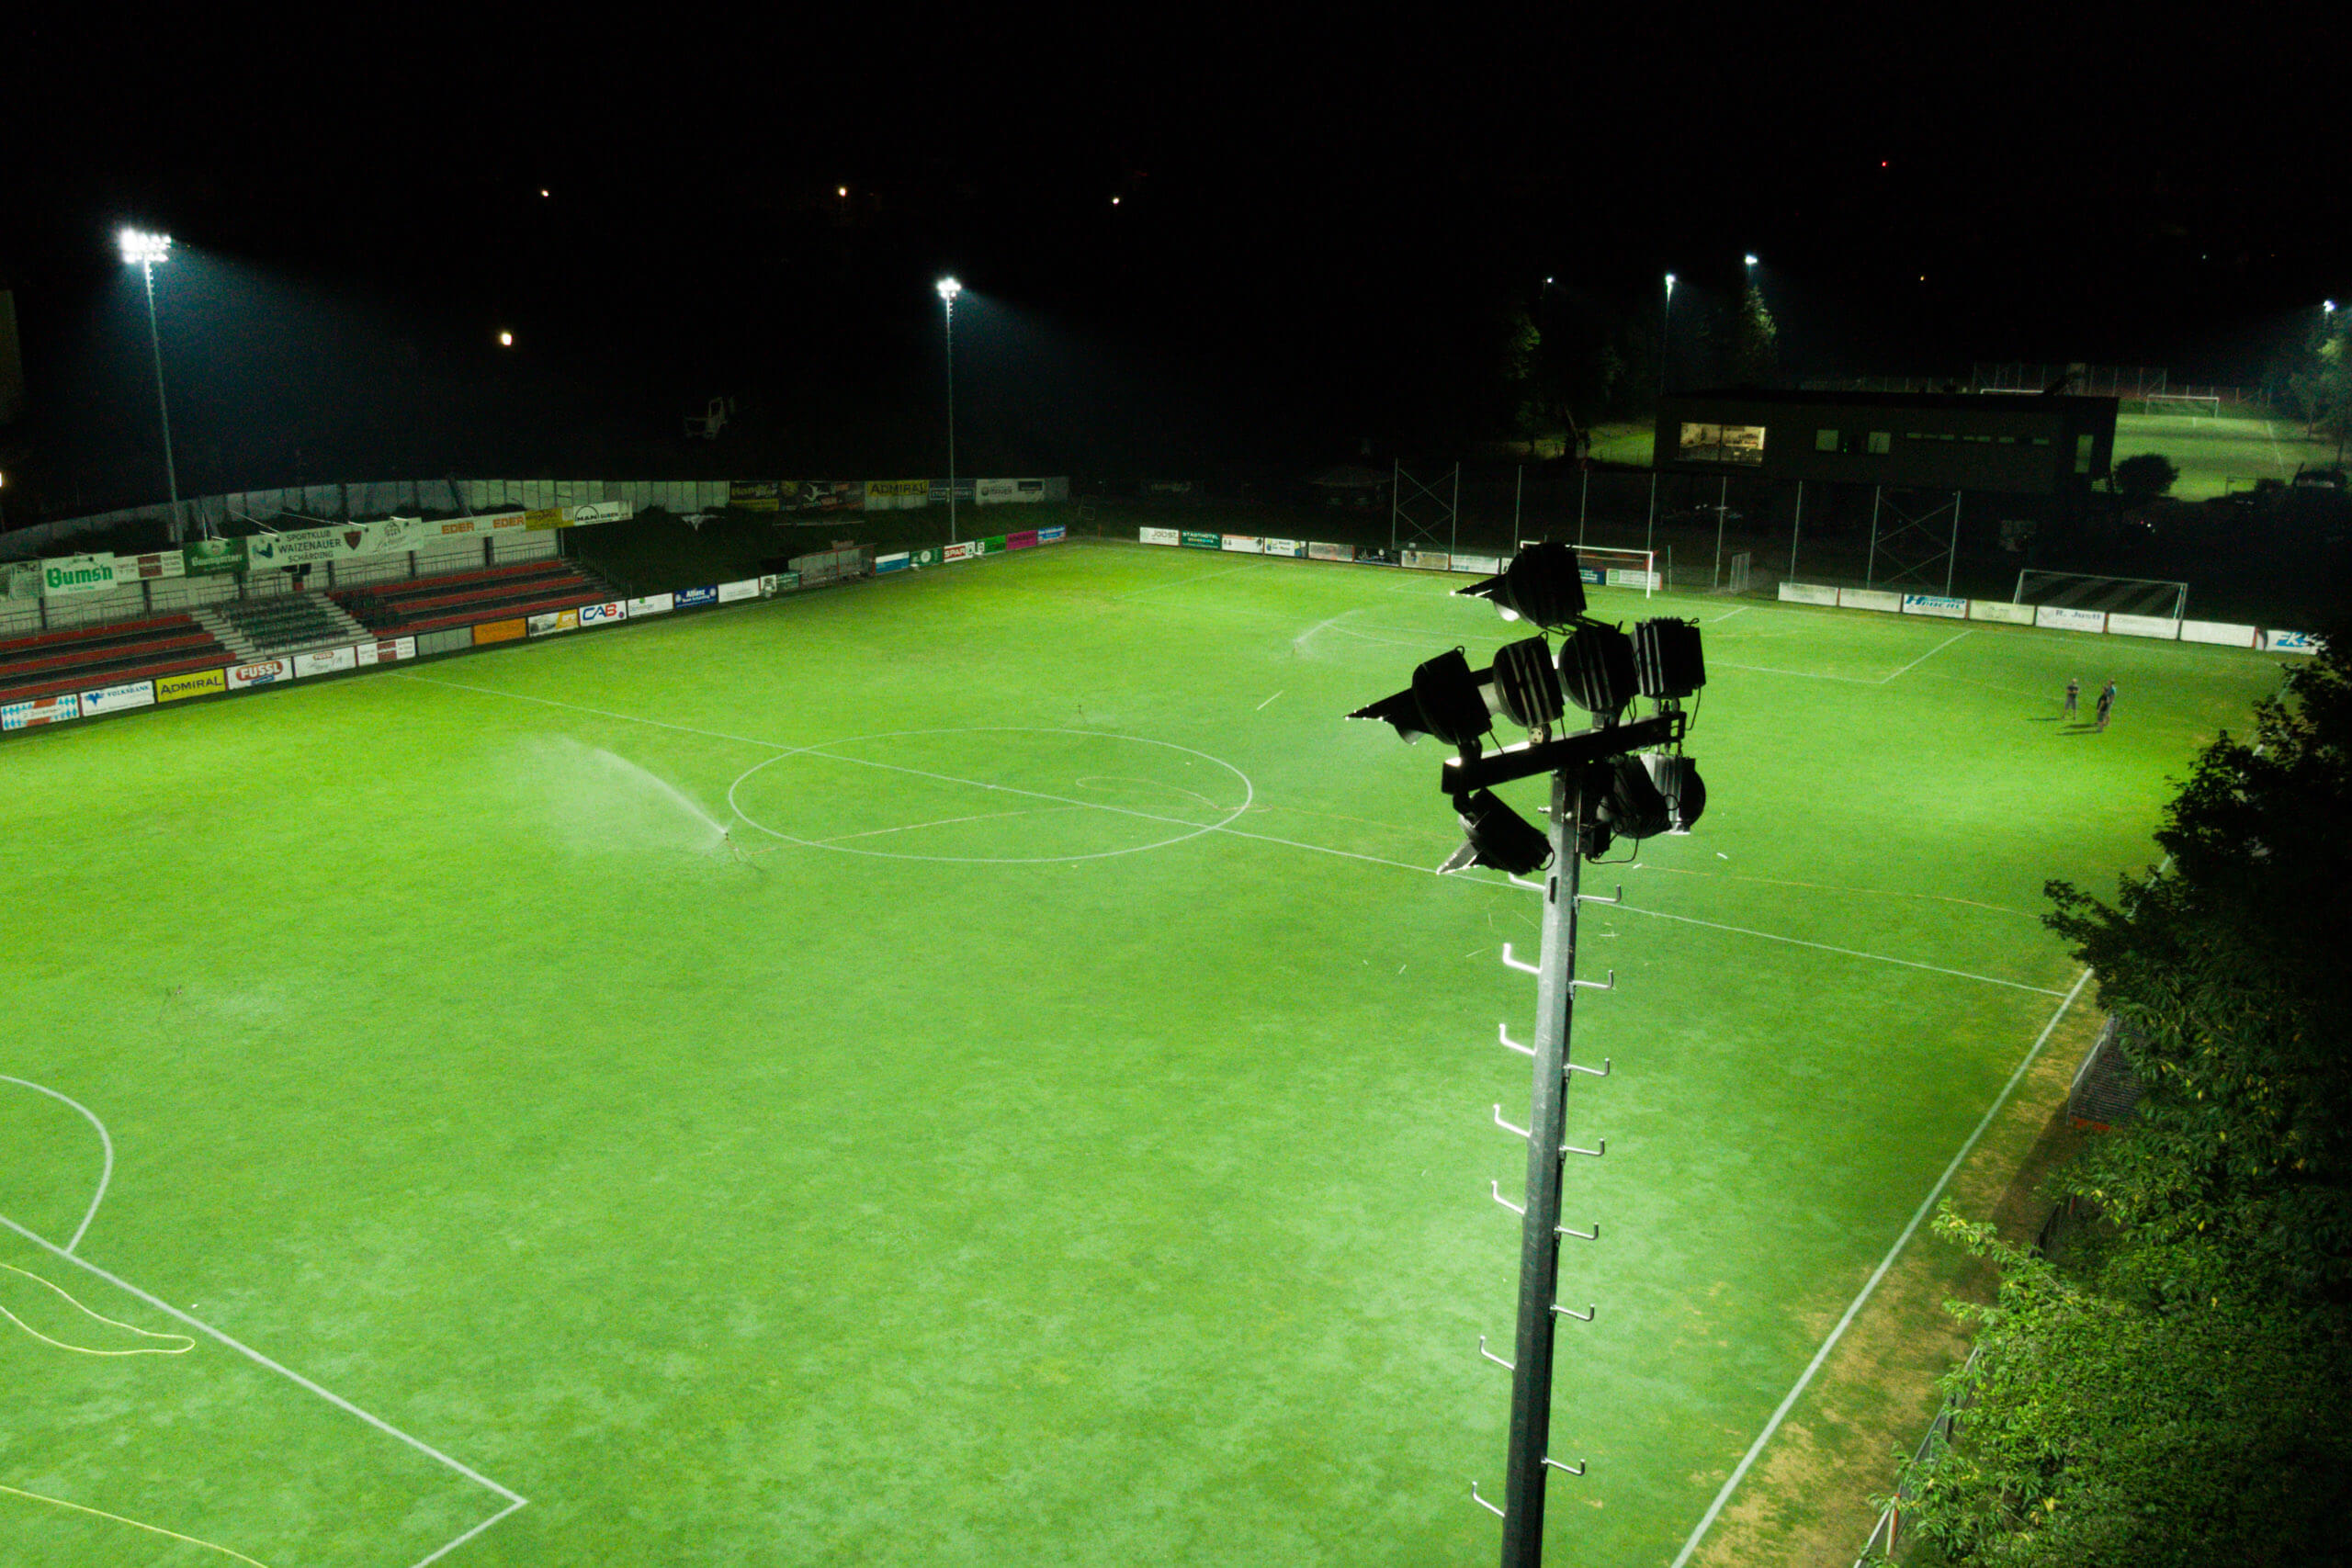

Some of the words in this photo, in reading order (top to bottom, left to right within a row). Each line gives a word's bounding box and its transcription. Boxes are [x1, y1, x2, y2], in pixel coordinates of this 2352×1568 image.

[871, 483, 927, 494] ADMIRAL
[441, 522, 474, 535] EDER
[492, 515, 524, 529] EDER
[286, 530, 331, 542] SPORTKLUB
[278, 539, 342, 553] WAIZENAUER
[944, 547, 965, 558] SPAR
[582, 604, 617, 621] CAB
[240, 662, 281, 679] FUSSL
[107, 684, 150, 698] VOLKSBANK
[160, 676, 222, 695] ADMIRAL
